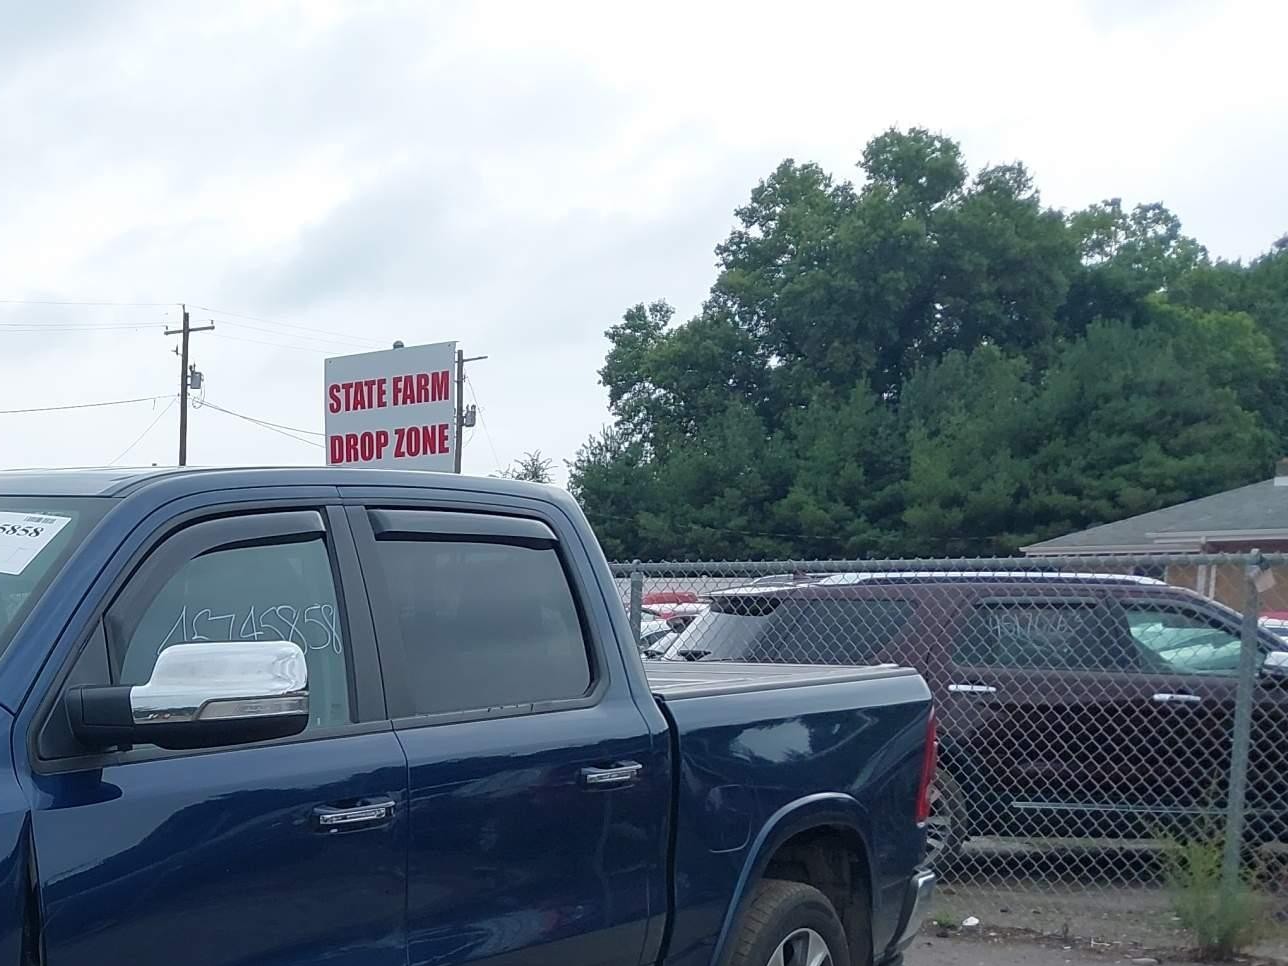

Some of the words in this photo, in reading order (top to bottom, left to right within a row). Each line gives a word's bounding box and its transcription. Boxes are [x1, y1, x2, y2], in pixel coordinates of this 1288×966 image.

[328, 378, 388, 414] STATE
[392, 370, 450, 406] FARM
[330, 430, 389, 464] DROP
[394, 423, 450, 458] ZONE
